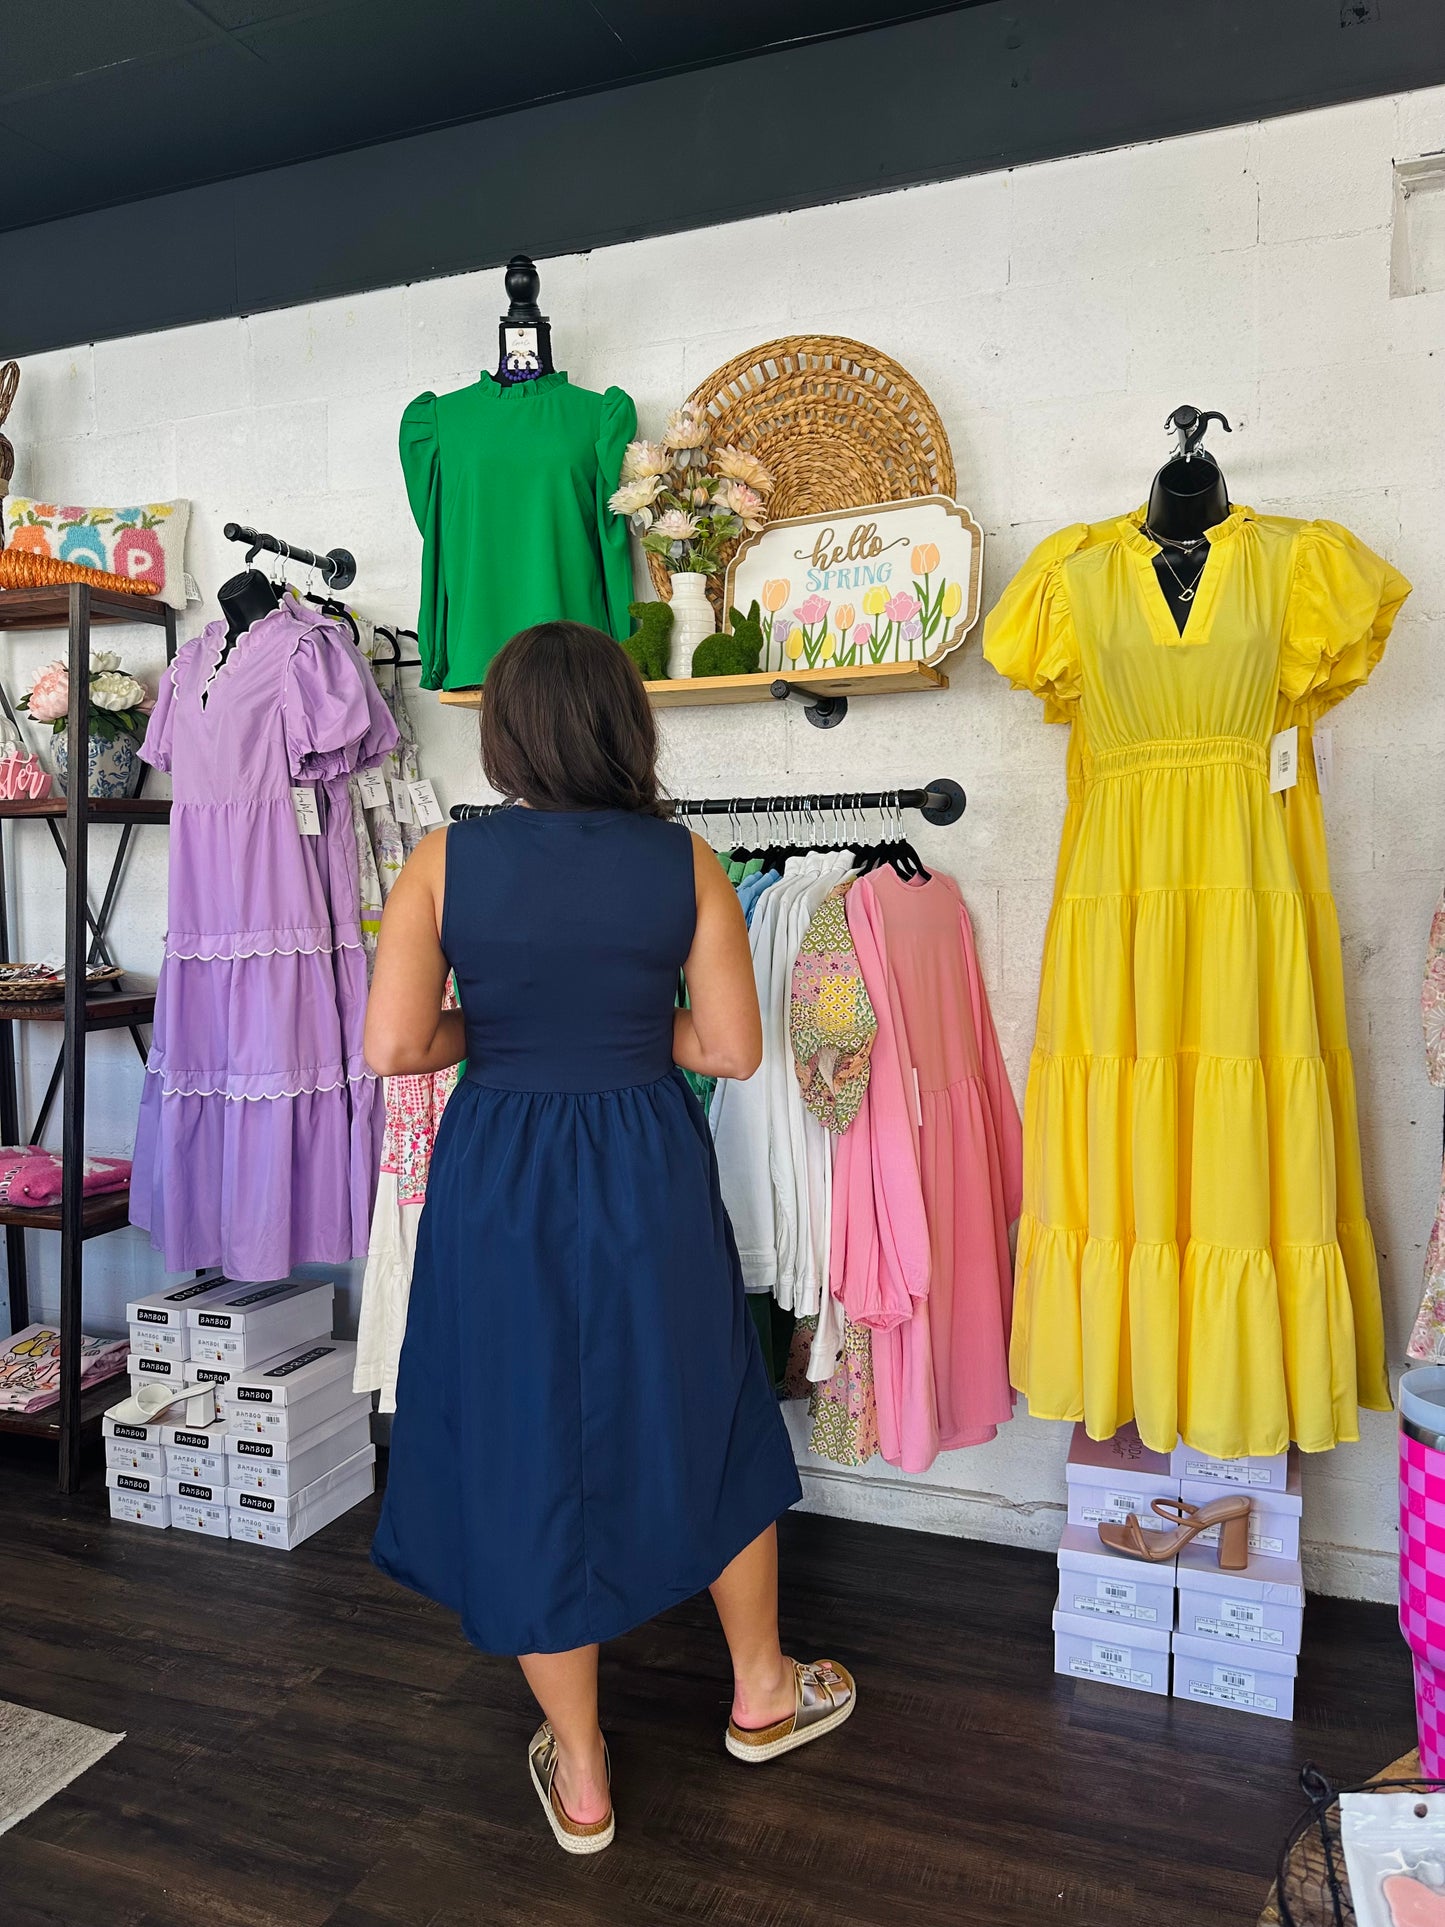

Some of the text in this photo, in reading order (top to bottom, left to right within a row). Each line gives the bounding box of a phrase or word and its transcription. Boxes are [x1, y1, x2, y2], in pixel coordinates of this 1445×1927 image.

[794, 522, 910, 571] hello
[806, 562, 893, 592] SPRING
[138, 1311, 167, 1322] BAMBOO
[200, 1316, 229, 1326] BAMBOO
[140, 1361, 169, 1372] BAMBOO
[198, 1372, 228, 1382] BAMBOO
[239, 1390, 270, 1400] BAMBOO
[115, 1427, 145, 1438] BAMBOO
[176, 1434, 207, 1446] BAMBOO
[239, 1443, 271, 1454] BAMBOO
[119, 1478, 148, 1490] BAMBOO
[180, 1485, 210, 1498] BAMBOO
[241, 1496, 273, 1510] BAMBOO
